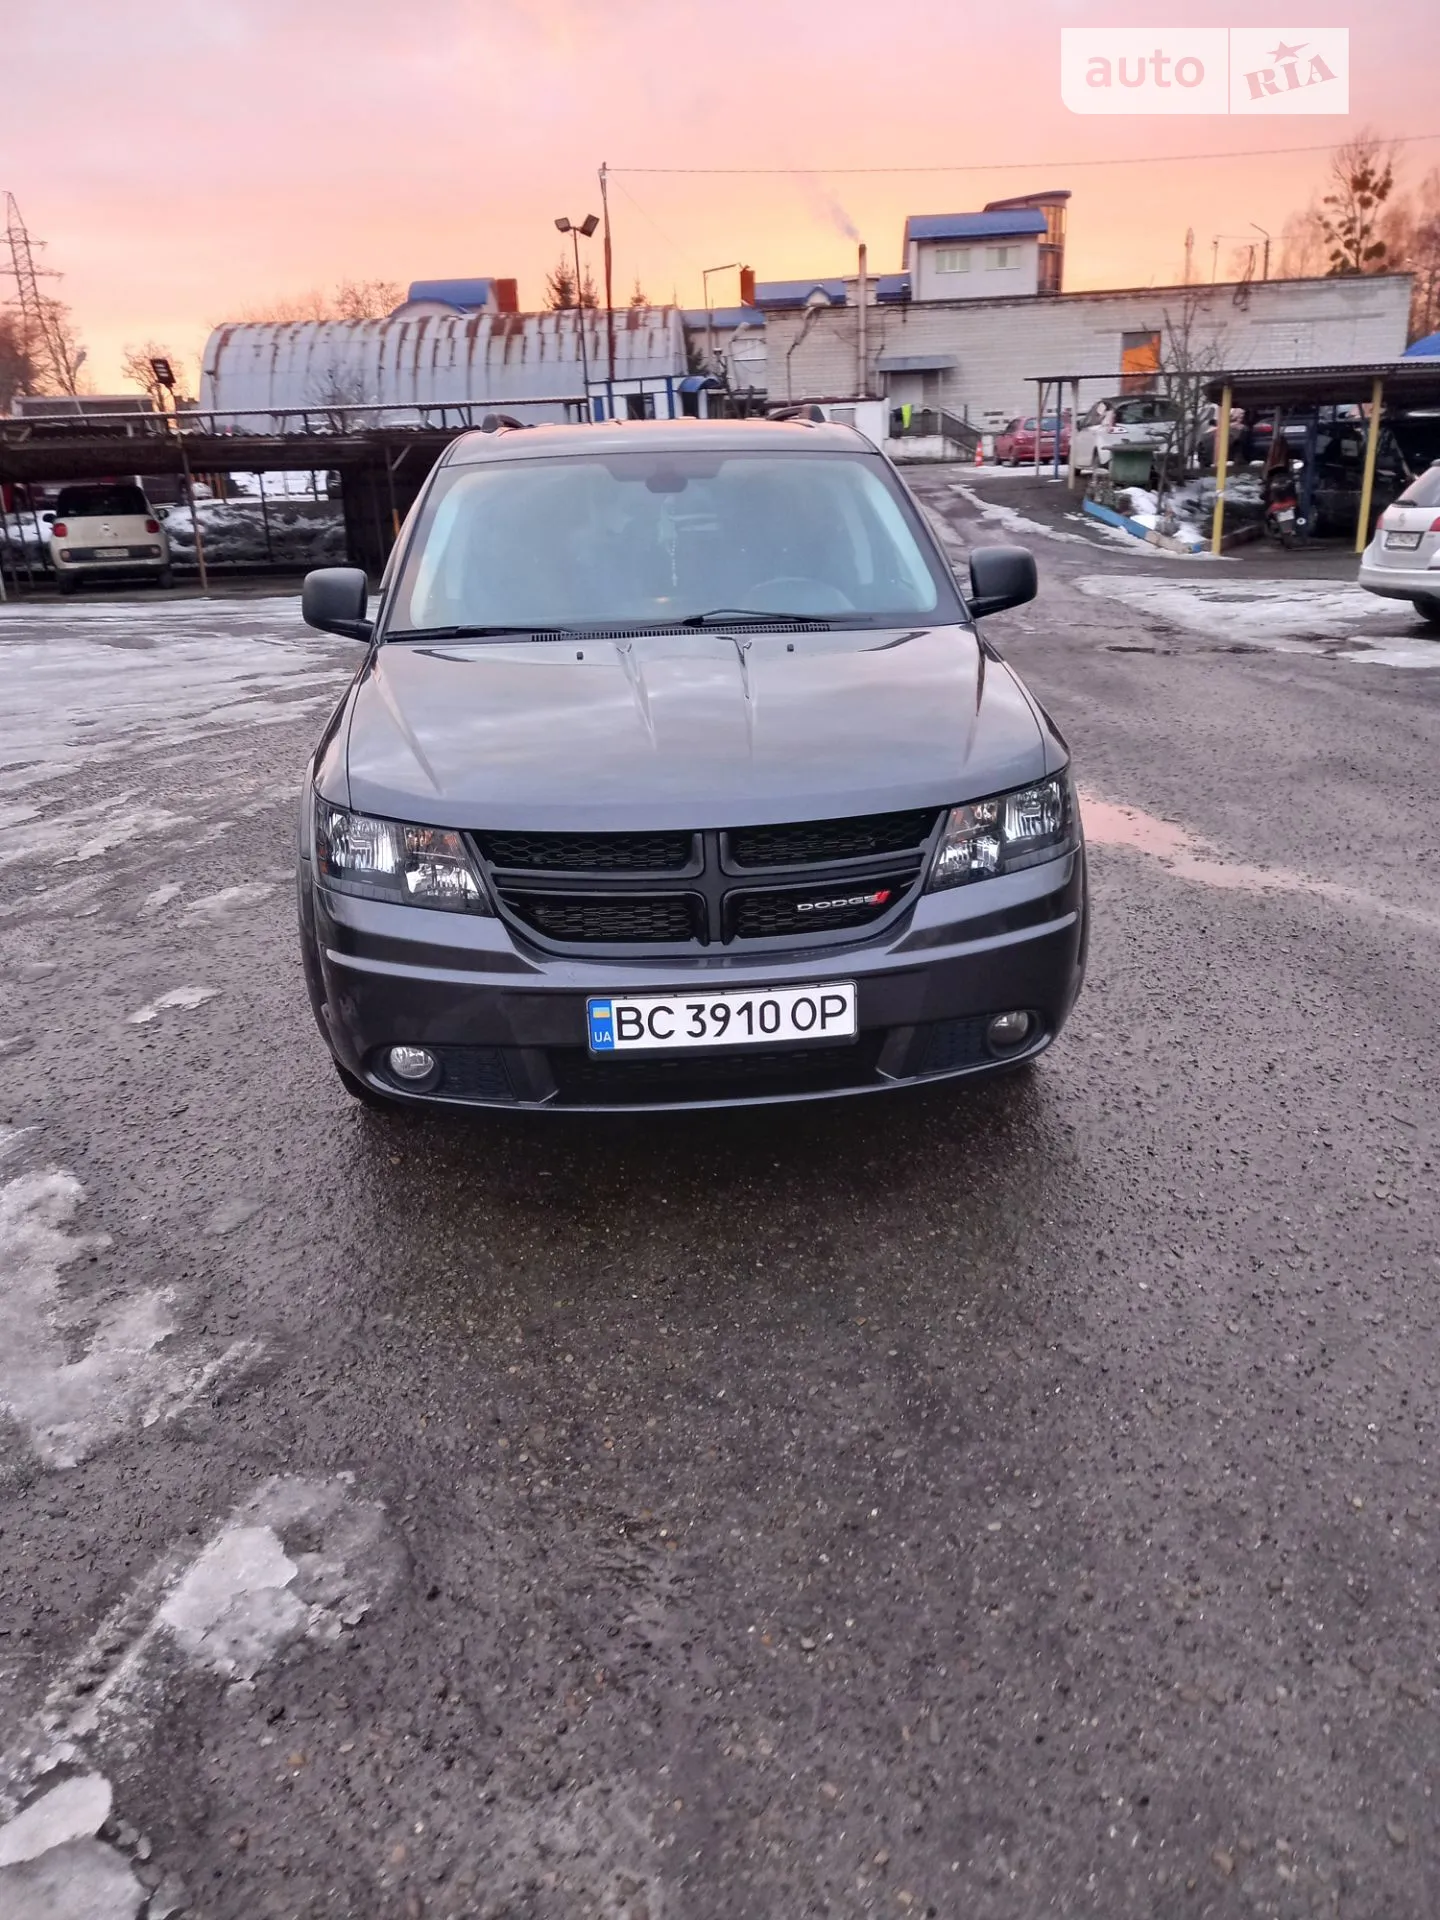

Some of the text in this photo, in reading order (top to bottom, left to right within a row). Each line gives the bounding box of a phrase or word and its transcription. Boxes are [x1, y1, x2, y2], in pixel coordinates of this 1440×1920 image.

[797, 894, 878, 912] DODGE
[615, 994, 848, 1041] BC 3910 OP
[594, 1031, 612, 1043] UA
